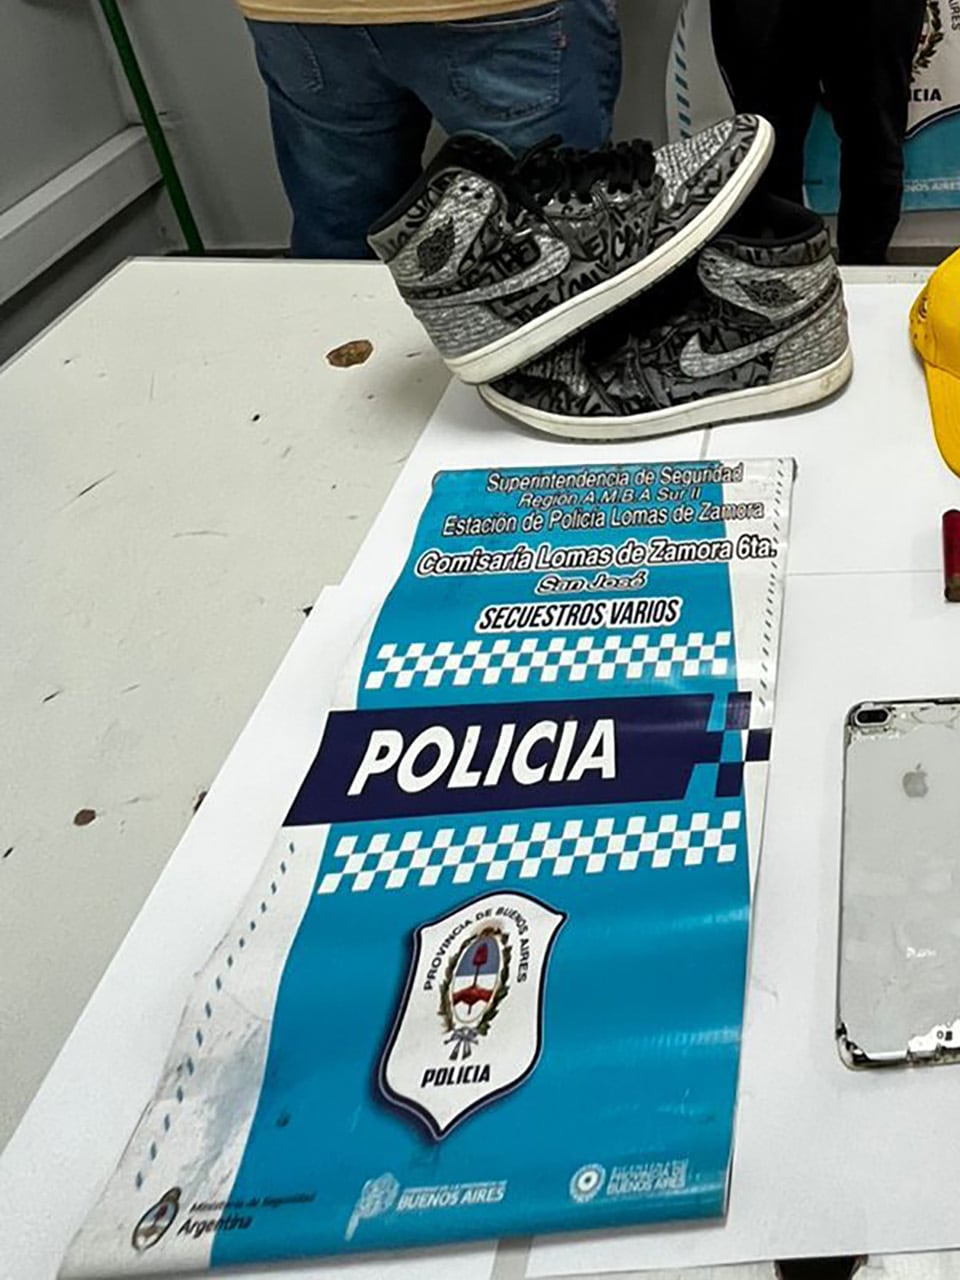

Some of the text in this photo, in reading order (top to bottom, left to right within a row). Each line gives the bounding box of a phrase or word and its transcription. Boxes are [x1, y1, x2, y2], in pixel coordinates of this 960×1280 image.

[487, 463, 744, 492] Superintendencia de Seguridad
[656, 487, 685, 502] Sur
[443, 514, 518, 537] Estación
[521, 511, 544, 533] de
[610, 506, 670, 527] Lomas
[673, 503, 695, 522] de
[698, 501, 765, 521] Zamora
[418, 534, 778, 576] Comisaría Lomas de Zamora 6ta.
[537, 570, 647, 593] San José
[479, 599, 679, 631] SECUESTROS VARIOS
[347, 718, 616, 796] POLICIA
[424, 906, 530, 991] PROVINCIA DE BUENOS AIRES
[421, 1064, 491, 1087] POLICIA
[397, 1187, 504, 1210] BUENOS AIRES
[176, 1215, 253, 1238] Argentina
